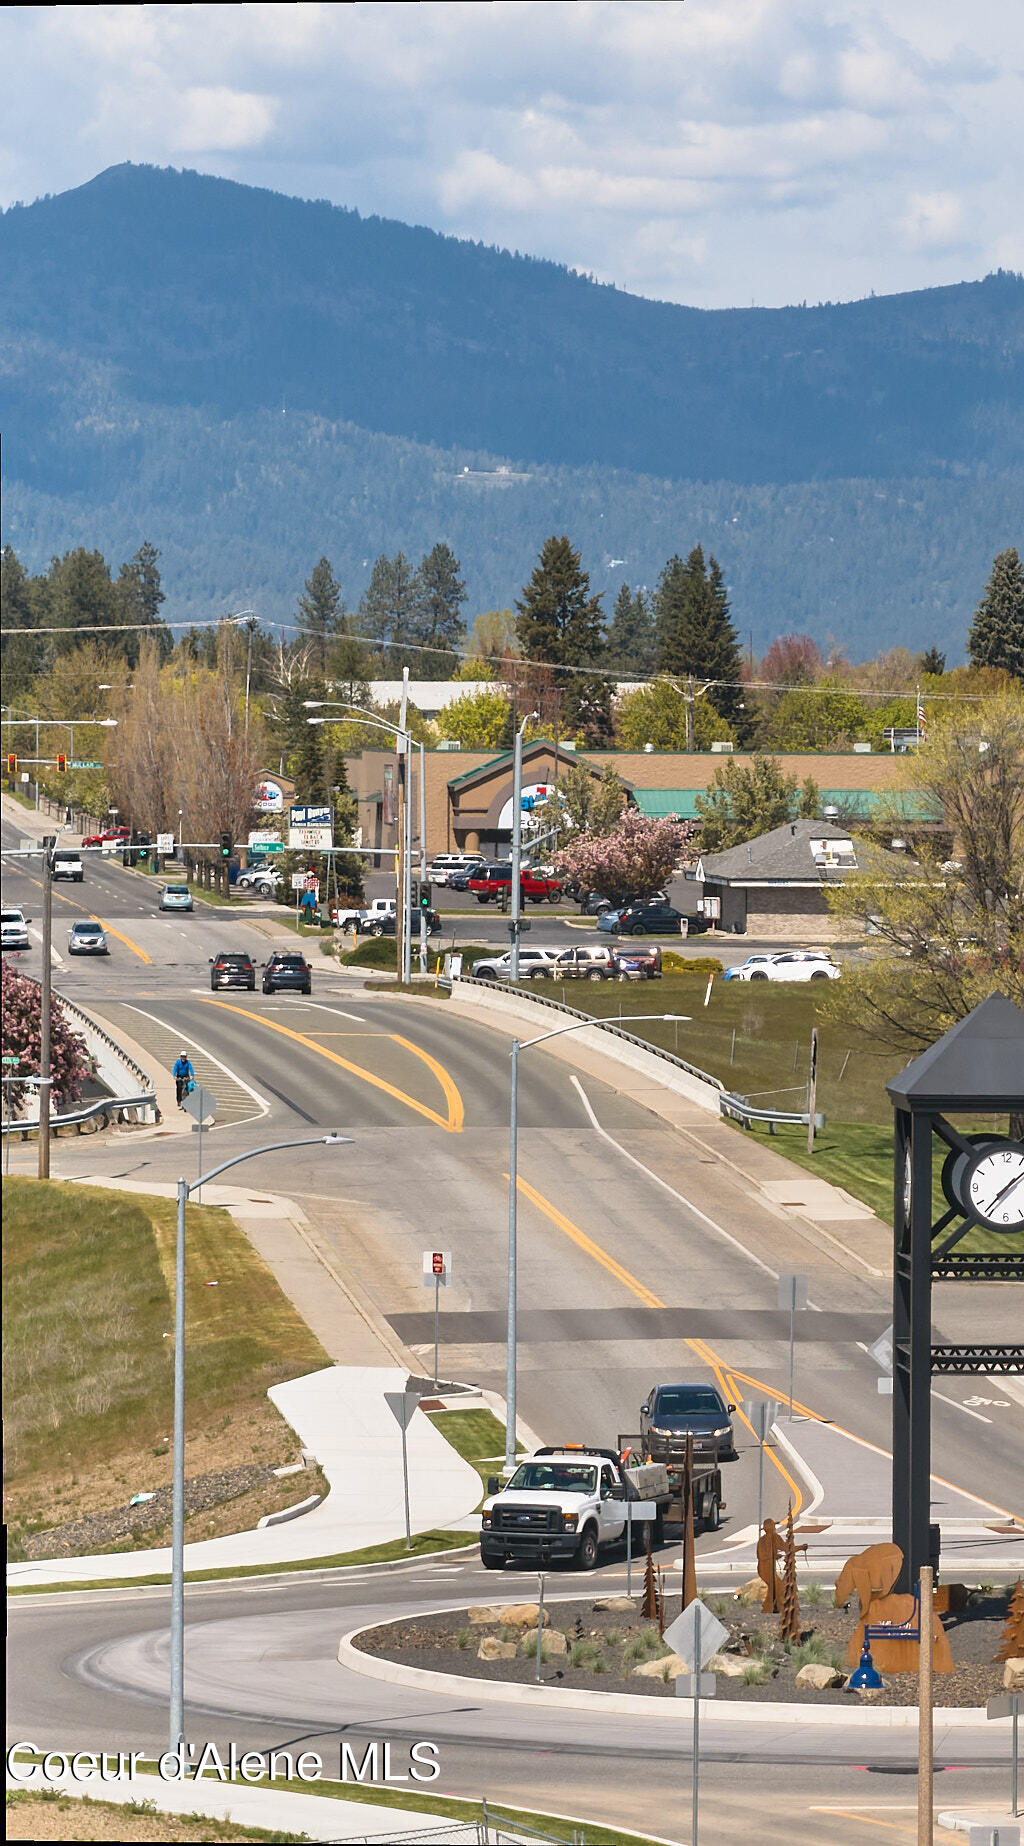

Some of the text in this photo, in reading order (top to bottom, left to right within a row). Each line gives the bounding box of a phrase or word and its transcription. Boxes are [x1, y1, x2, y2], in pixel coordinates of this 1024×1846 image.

[1001, 1152, 1013, 1163] 12
[972, 1182, 979, 1193] 9
[1002, 1212, 1010, 1222] 6
